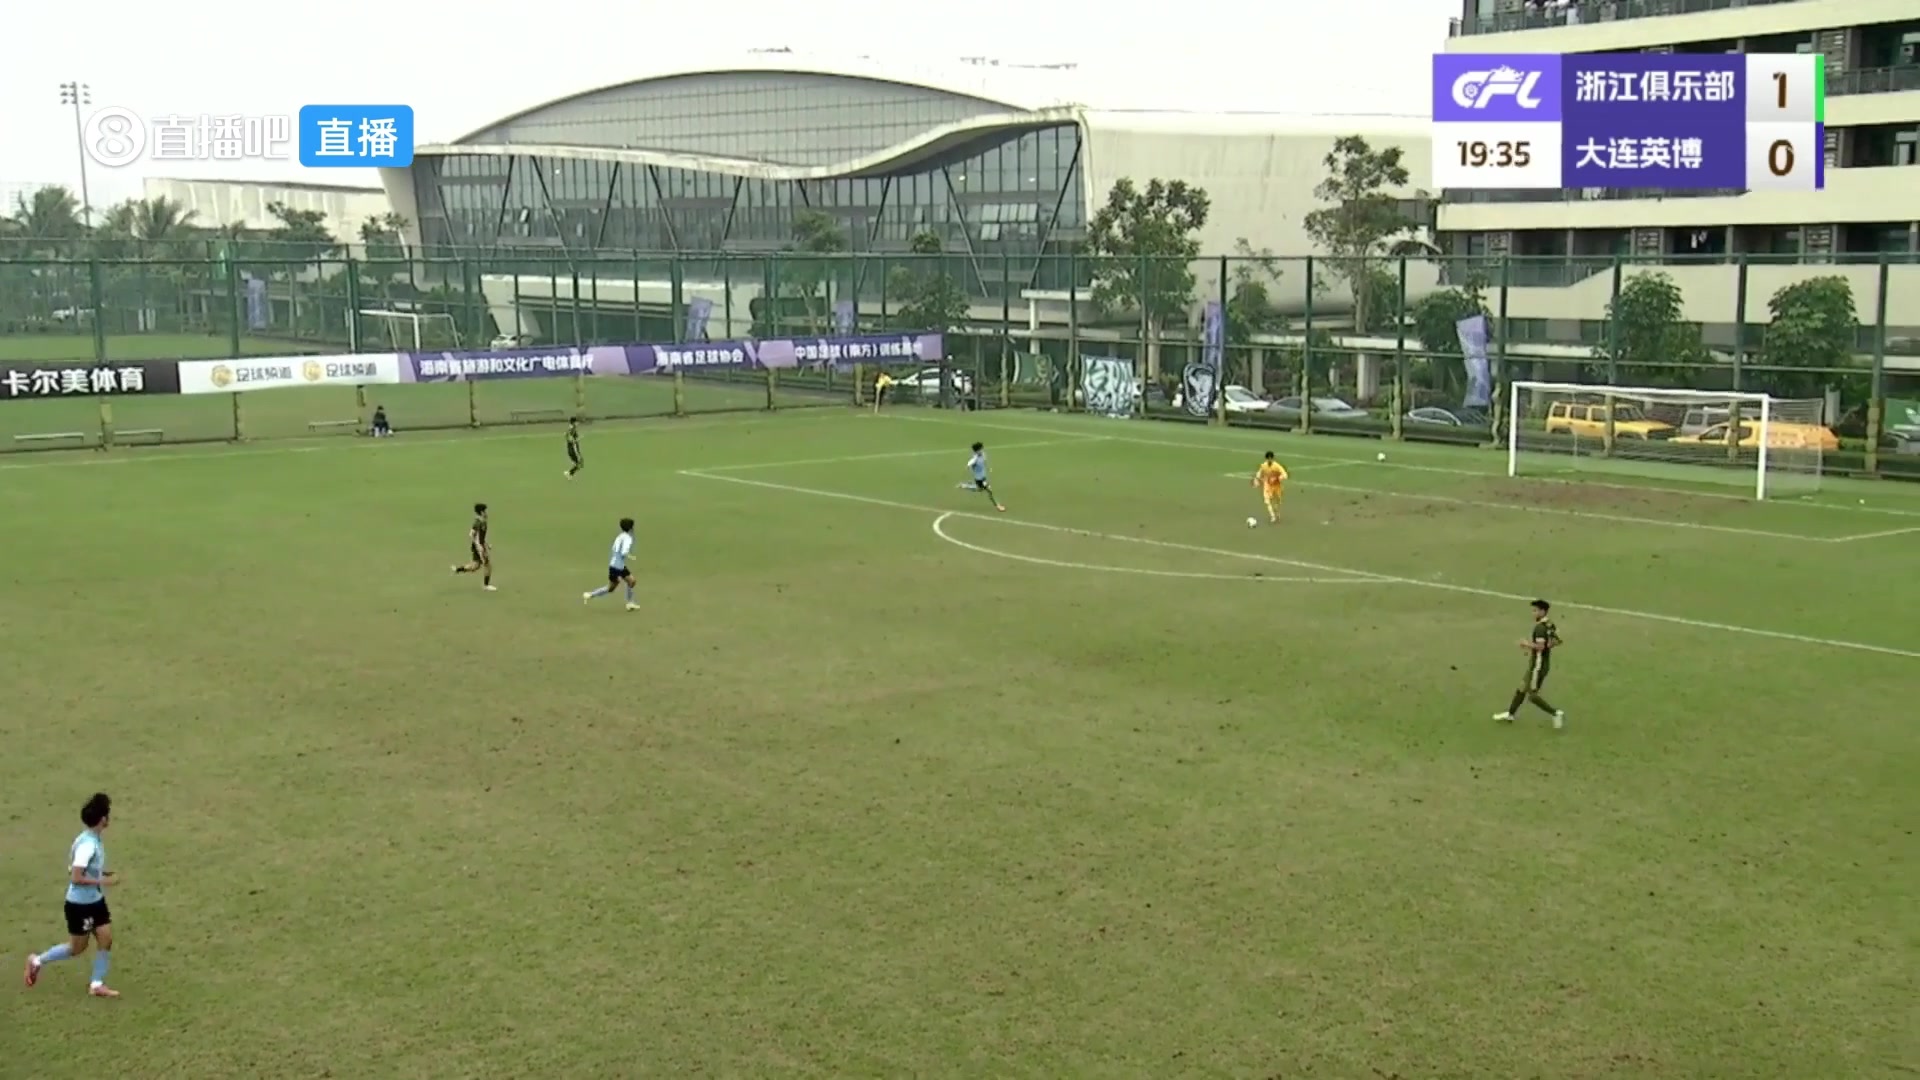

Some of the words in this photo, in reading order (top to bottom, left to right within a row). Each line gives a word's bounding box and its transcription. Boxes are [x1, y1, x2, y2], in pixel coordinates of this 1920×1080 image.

[2, 366, 144, 396] 卡尔美体育
